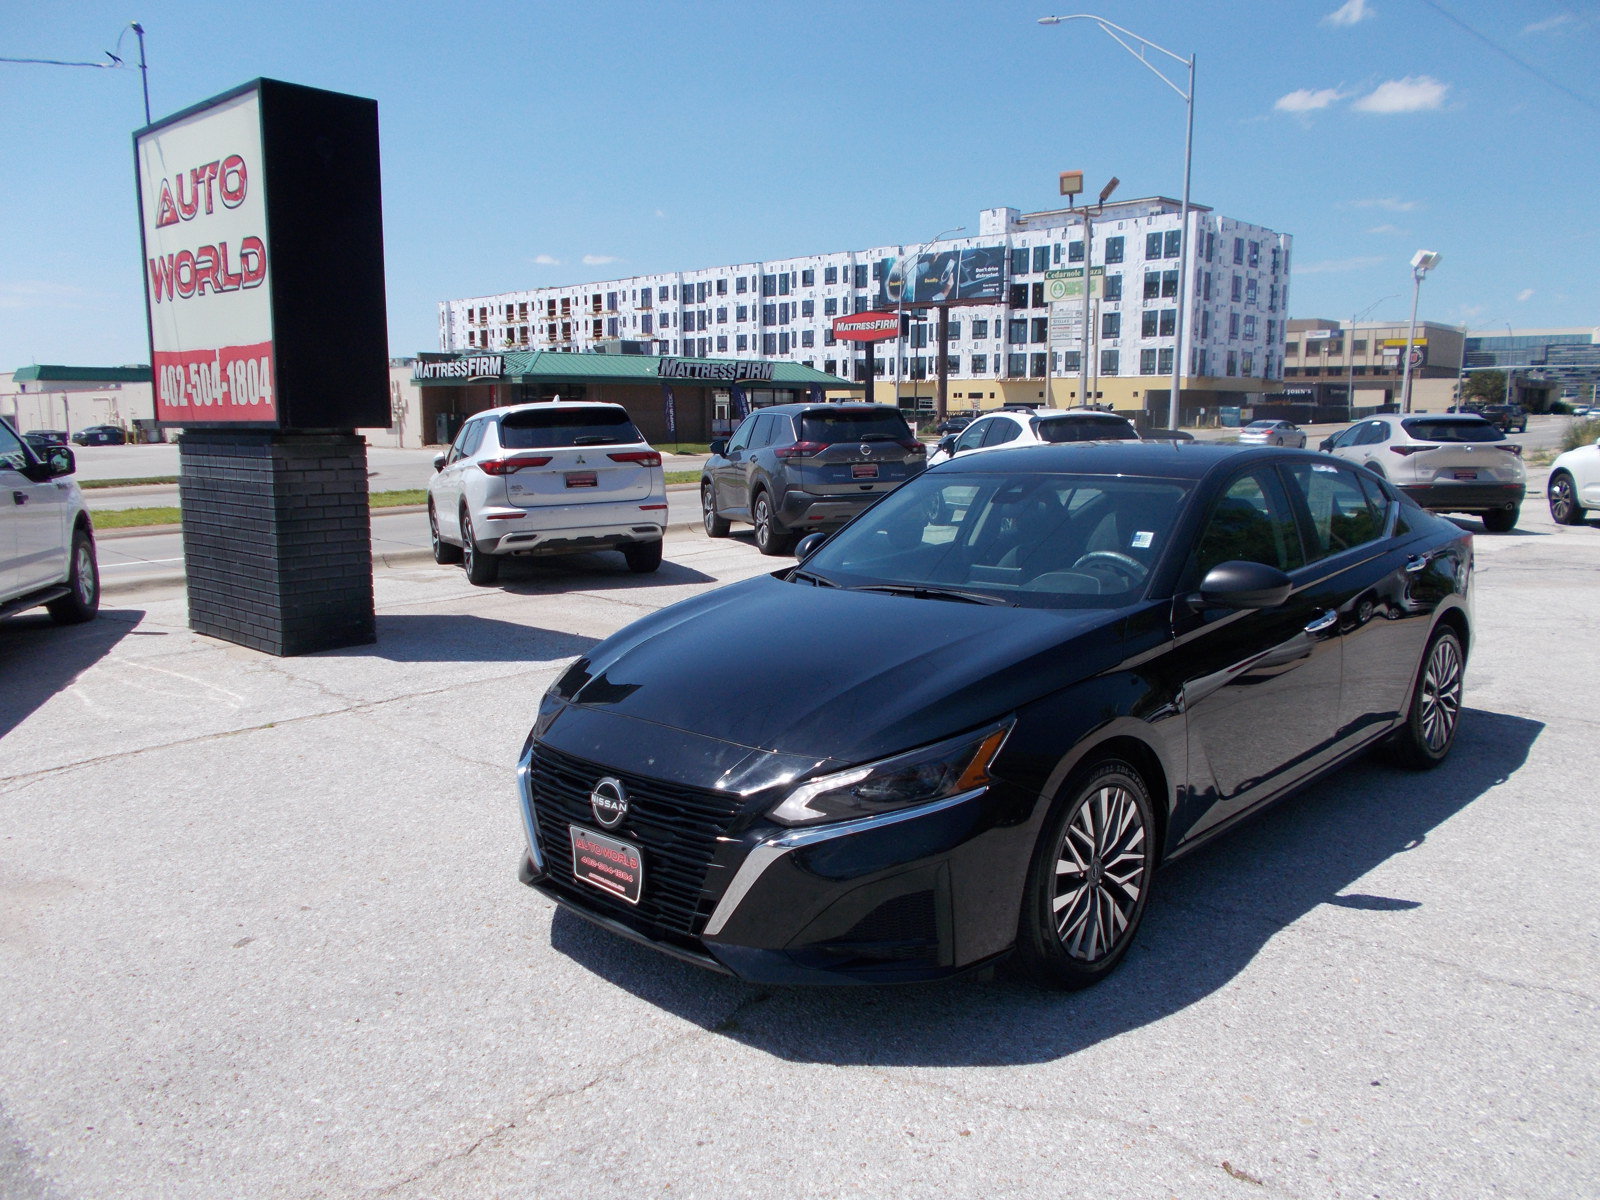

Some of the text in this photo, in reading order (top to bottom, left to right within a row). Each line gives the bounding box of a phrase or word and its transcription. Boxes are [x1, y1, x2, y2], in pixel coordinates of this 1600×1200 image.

[155, 154, 248, 229] AUTO
[148, 235, 267, 303] WORLD
[159, 357, 272, 408] 402-504-1804
[591, 793, 627, 812] NISSAN
[602, 848, 638, 869] WORLD
